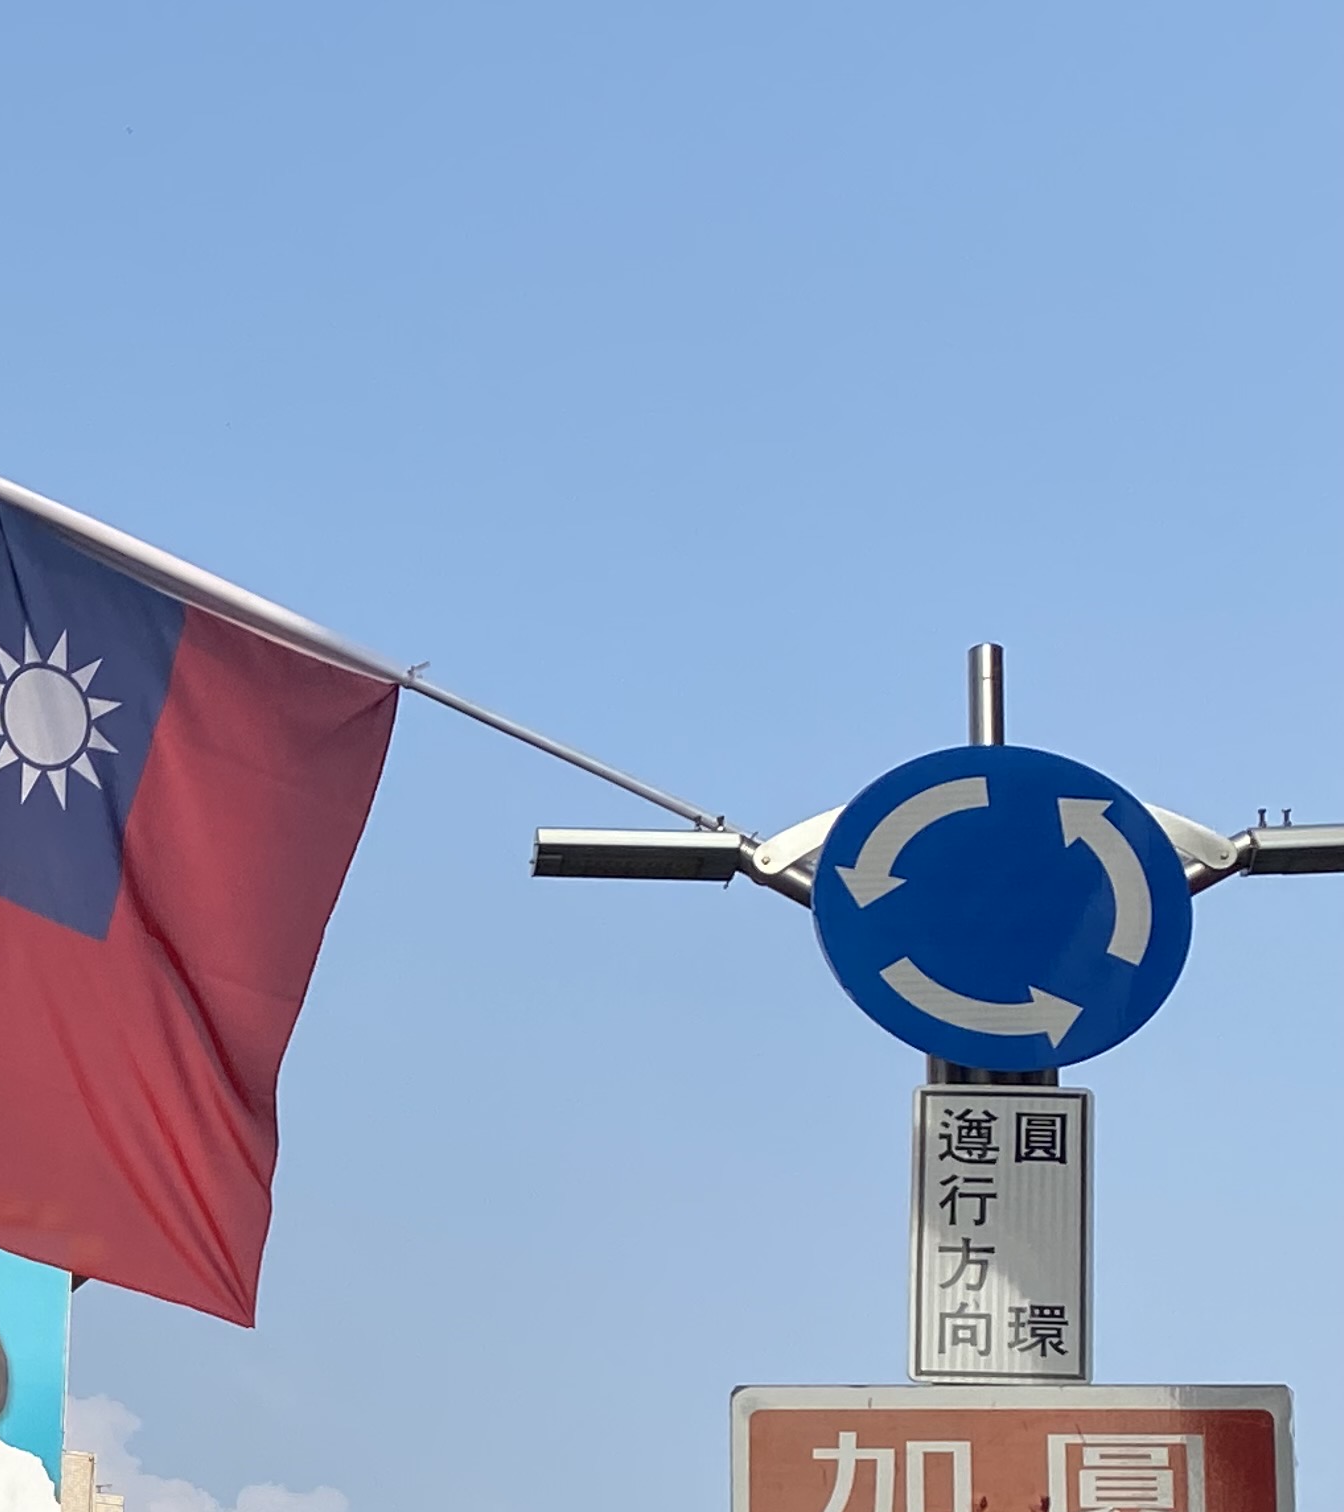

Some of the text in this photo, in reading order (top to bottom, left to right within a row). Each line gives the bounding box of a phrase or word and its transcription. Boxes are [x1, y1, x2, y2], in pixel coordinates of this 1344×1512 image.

[938, 1106, 999, 1358] 遵行方向
[1008, 1111, 1069, 1359] 圓環
